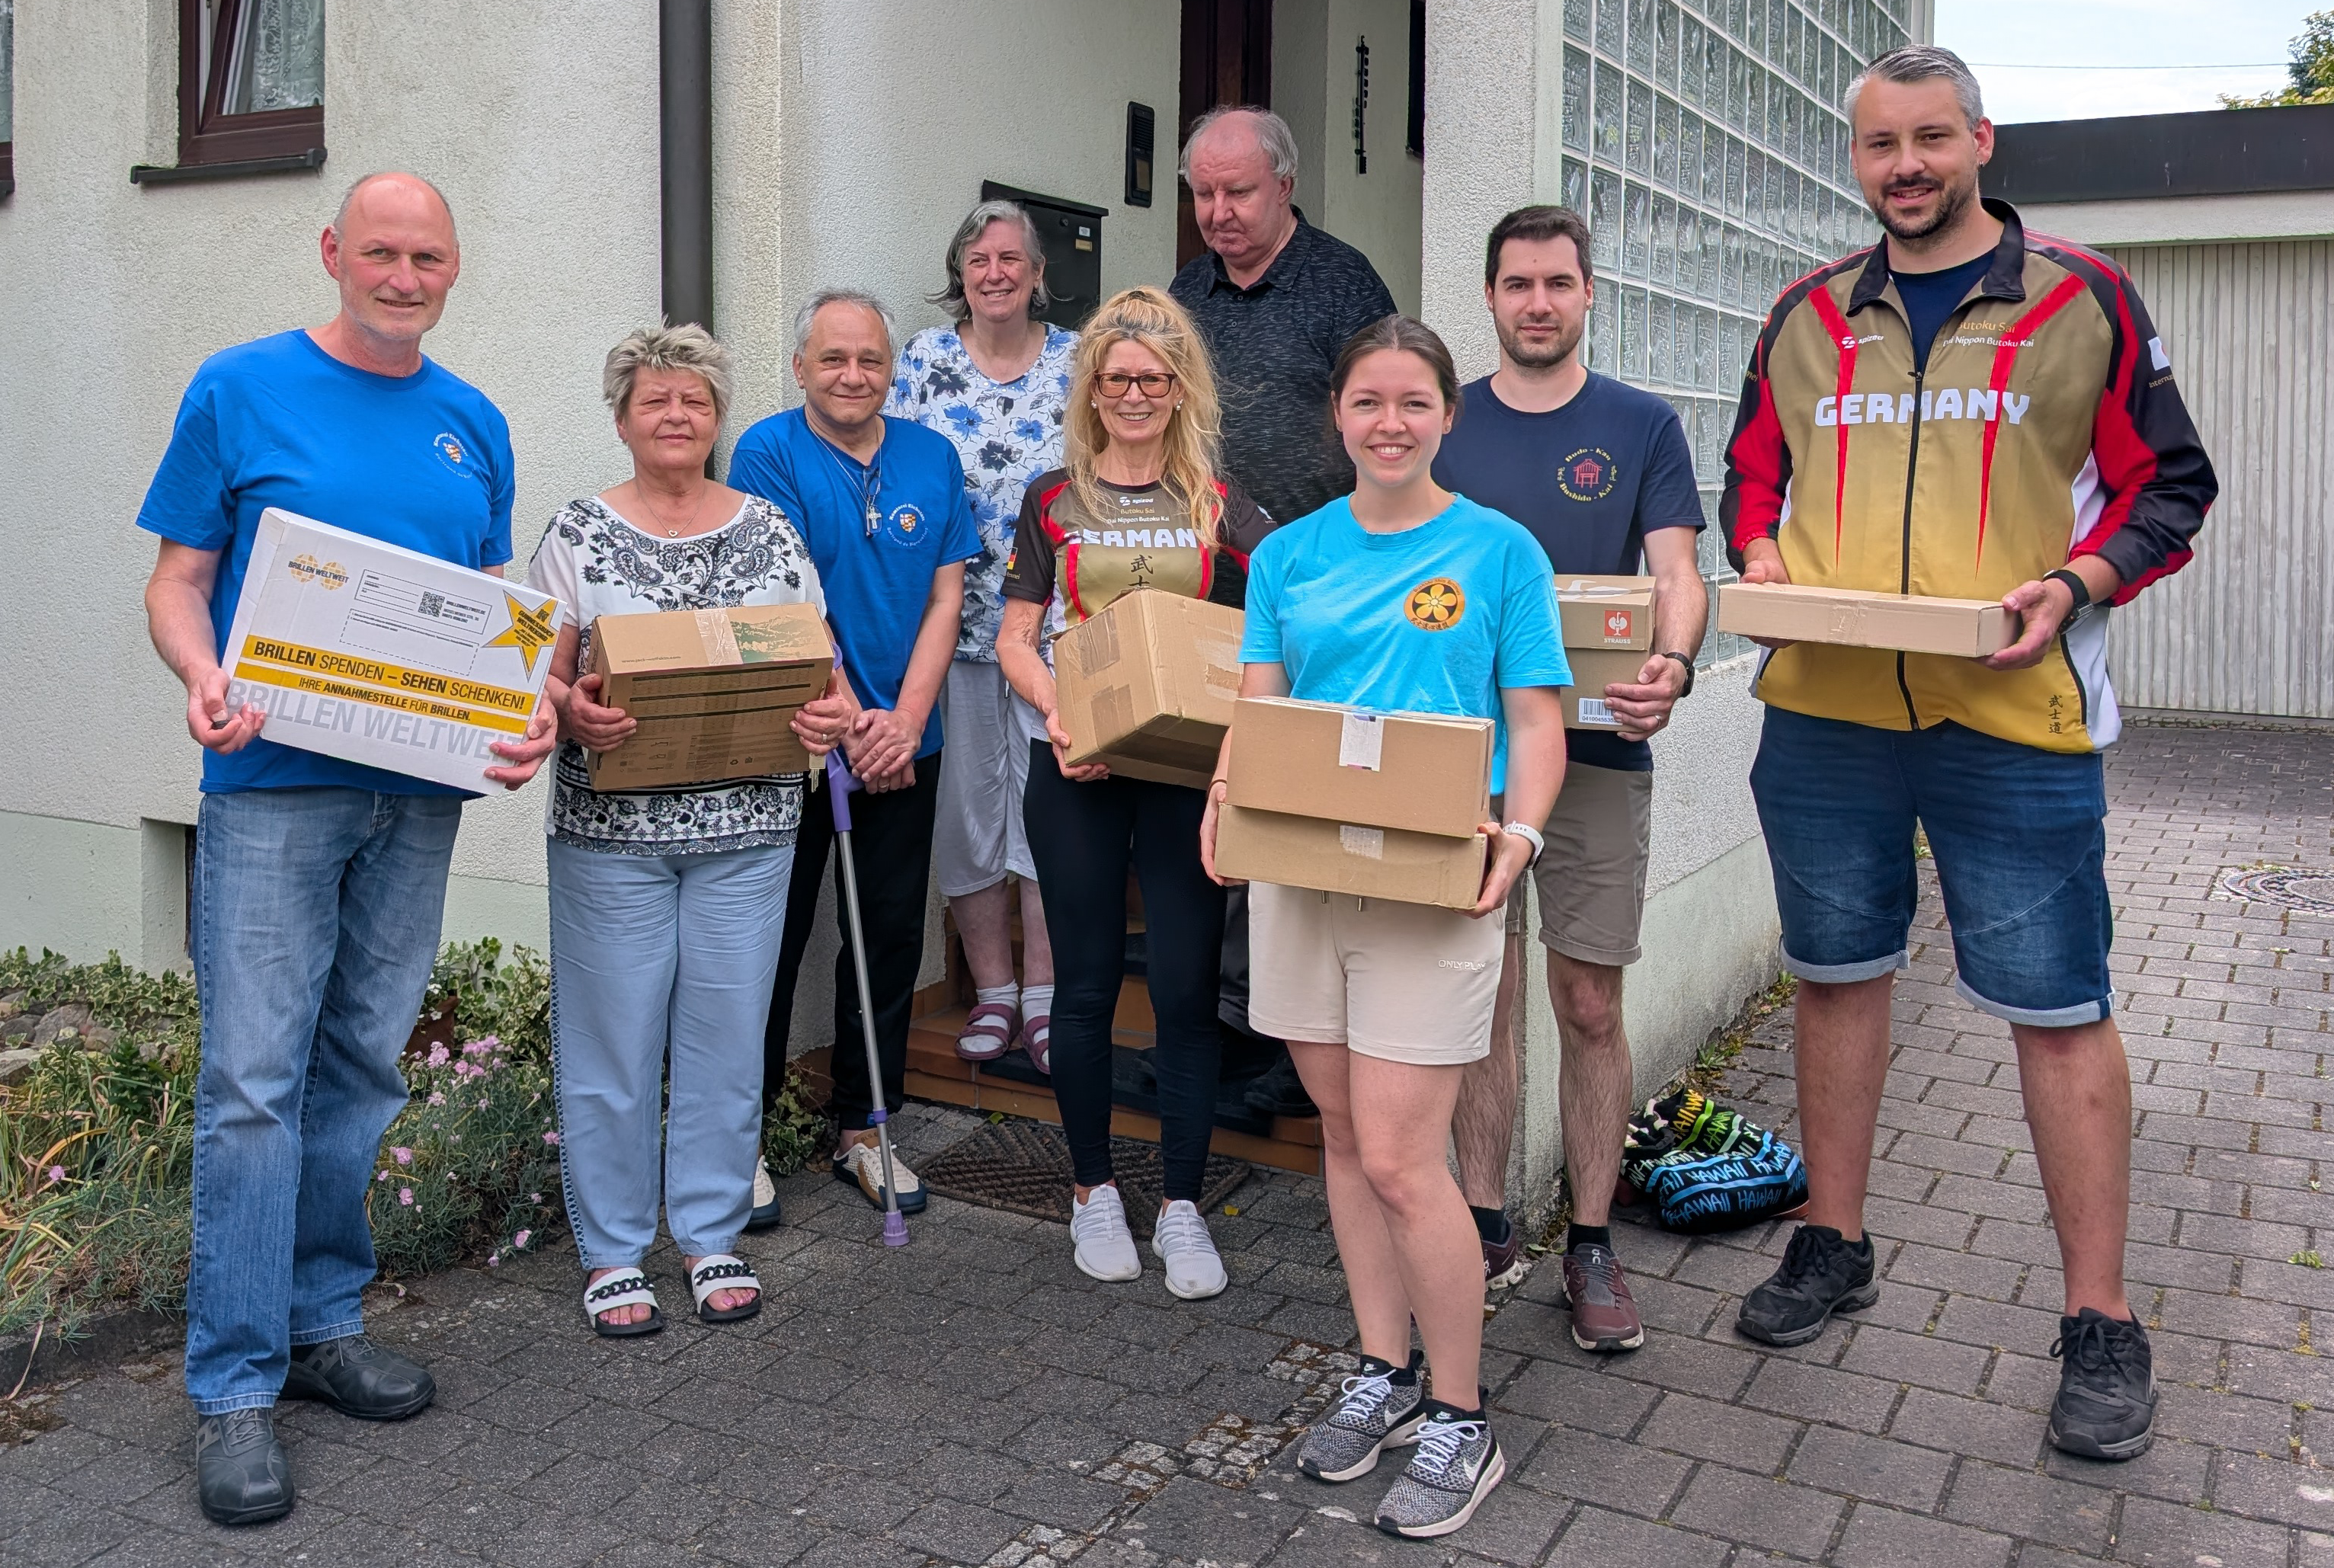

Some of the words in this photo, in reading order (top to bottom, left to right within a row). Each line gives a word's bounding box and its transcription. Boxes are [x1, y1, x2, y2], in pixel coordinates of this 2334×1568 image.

[1955, 336, 1985, 347] Nippon
[1987, 337, 2019, 347] Butoku
[2019, 339, 2035, 347] Kai
[1814, 388, 2030, 427] GERMANY
[1064, 528, 1201, 549] GERMAN
[254, 641, 316, 667] BRILLEN
[319, 654, 385, 680] SPENDEN
[400, 672, 447, 693] SEHEN
[450, 682, 525, 709] SCHENKEN!
[226, 680, 357, 734] BRILLEN
[299, 677, 322, 691] IHRE
[322, 683, 408, 709] ANNAHMESTELLE
[409, 699, 428, 713] FÜR
[1685, 1160, 1750, 1182] HAWAII
[1676, 1192, 1731, 1225] HAWAII
[1737, 1187, 1782, 1212] HAWAII
